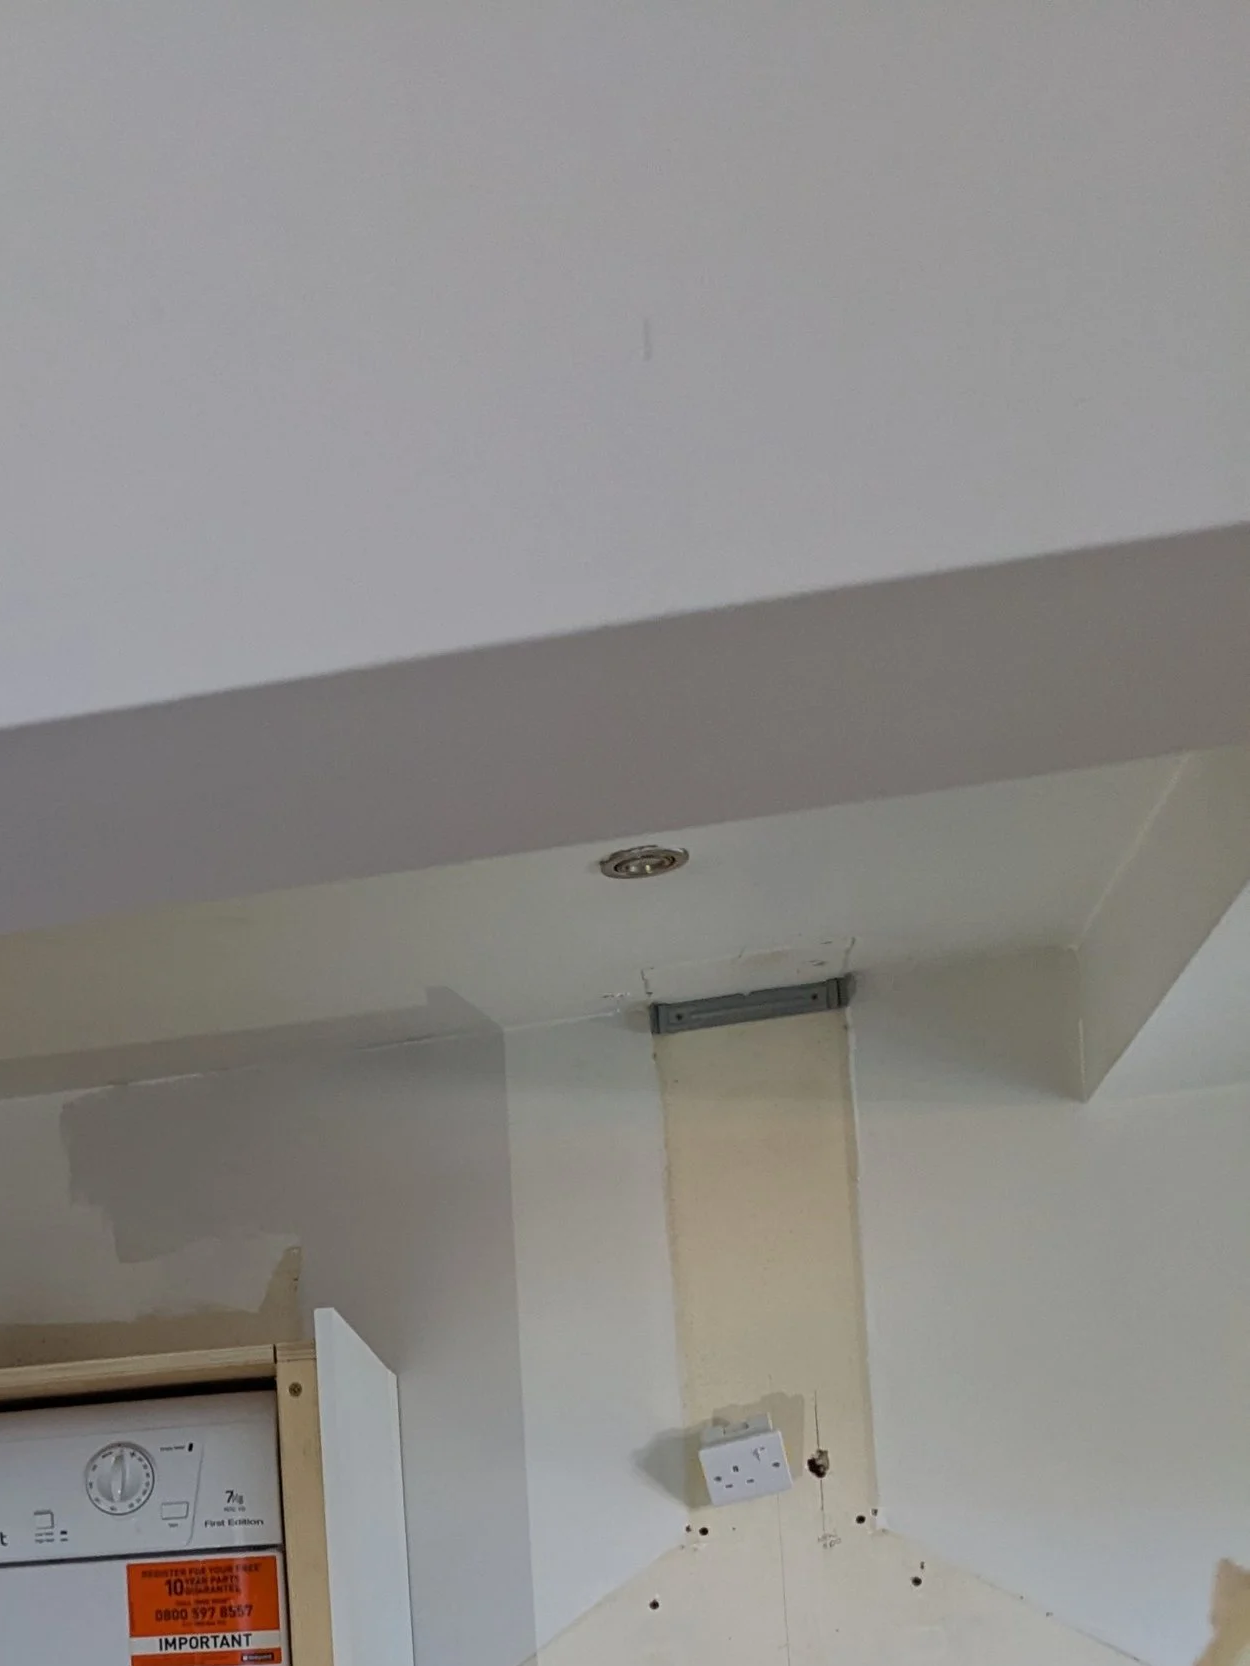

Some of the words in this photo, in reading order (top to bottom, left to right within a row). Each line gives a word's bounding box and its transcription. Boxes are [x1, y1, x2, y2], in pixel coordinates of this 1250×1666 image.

[204, 1519, 225, 1528] First
[227, 1517, 265, 1527] Edition
[164, 1578, 184, 1597] 10
[155, 1608, 188, 1622] 0800
[159, 1633, 253, 1651] IMPORTANT
